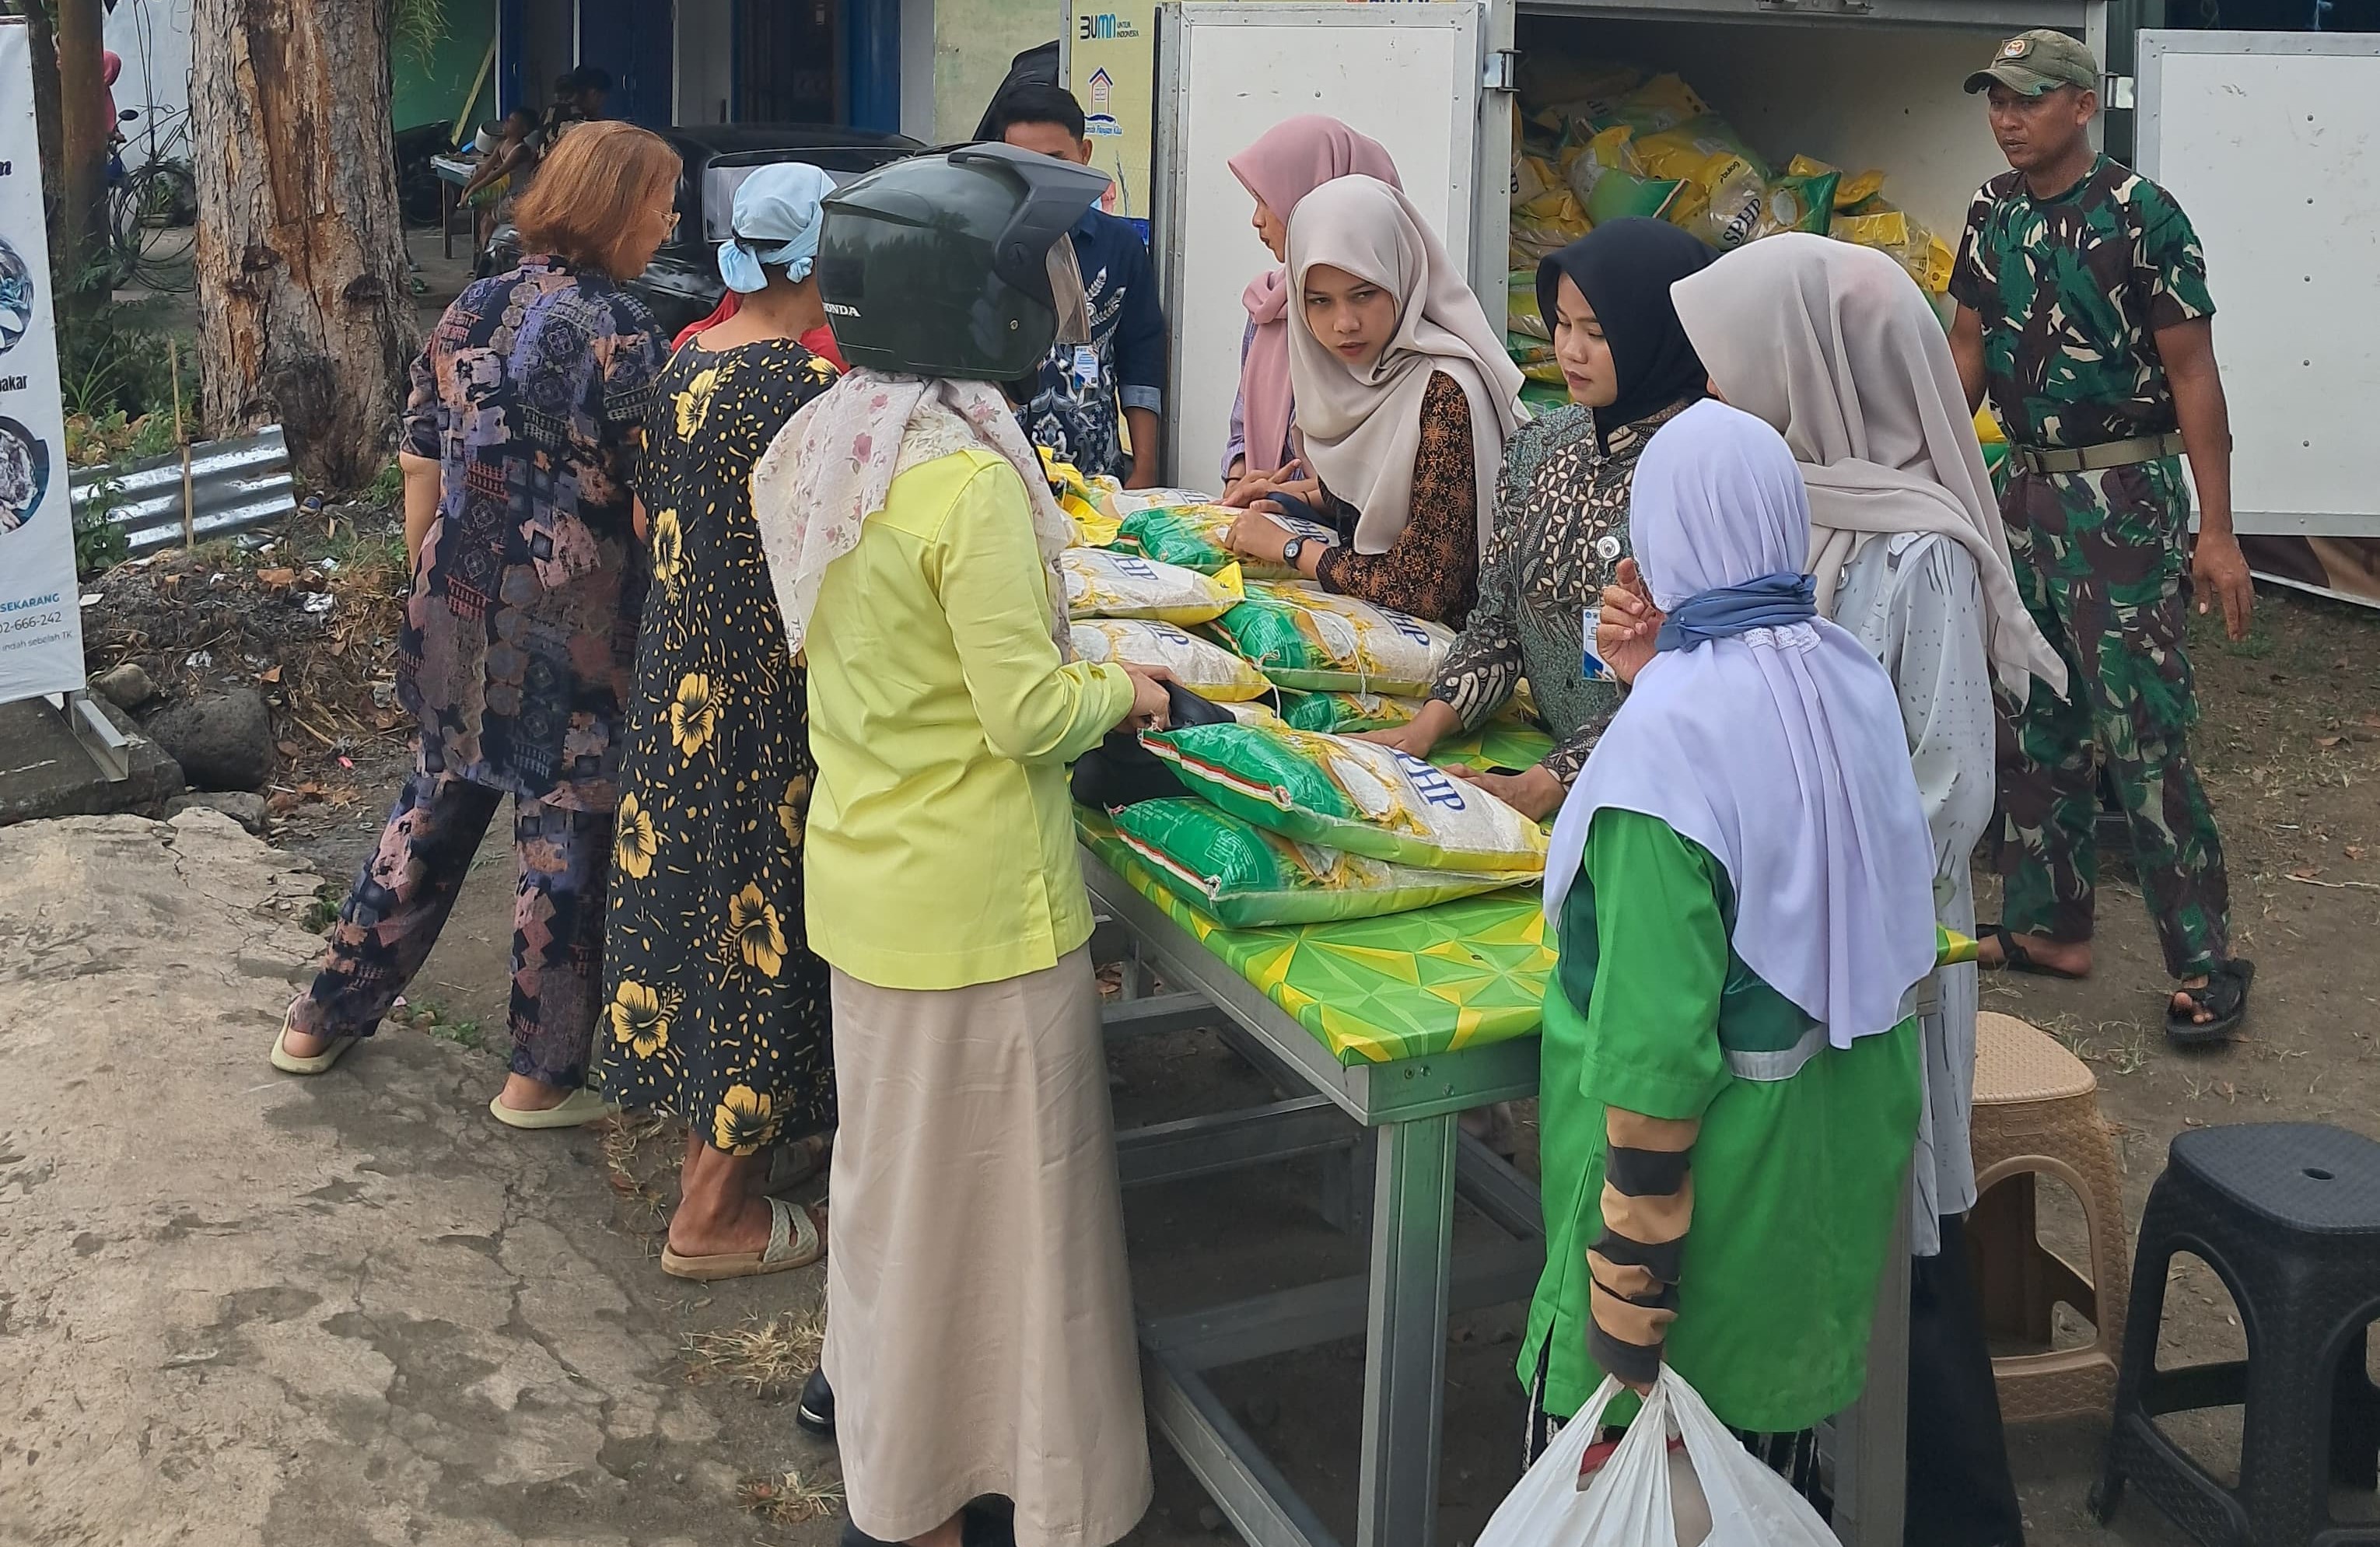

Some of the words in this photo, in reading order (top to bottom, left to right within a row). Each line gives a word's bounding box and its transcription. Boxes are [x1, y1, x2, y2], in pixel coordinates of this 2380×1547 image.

[1723, 198, 1761, 245] SPHP
[1112, 556, 1159, 581] HP
[0, 593, 60, 613] SEKARANG
[1374, 607, 1431, 646] PHP
[1389, 750, 1466, 810] PHP
